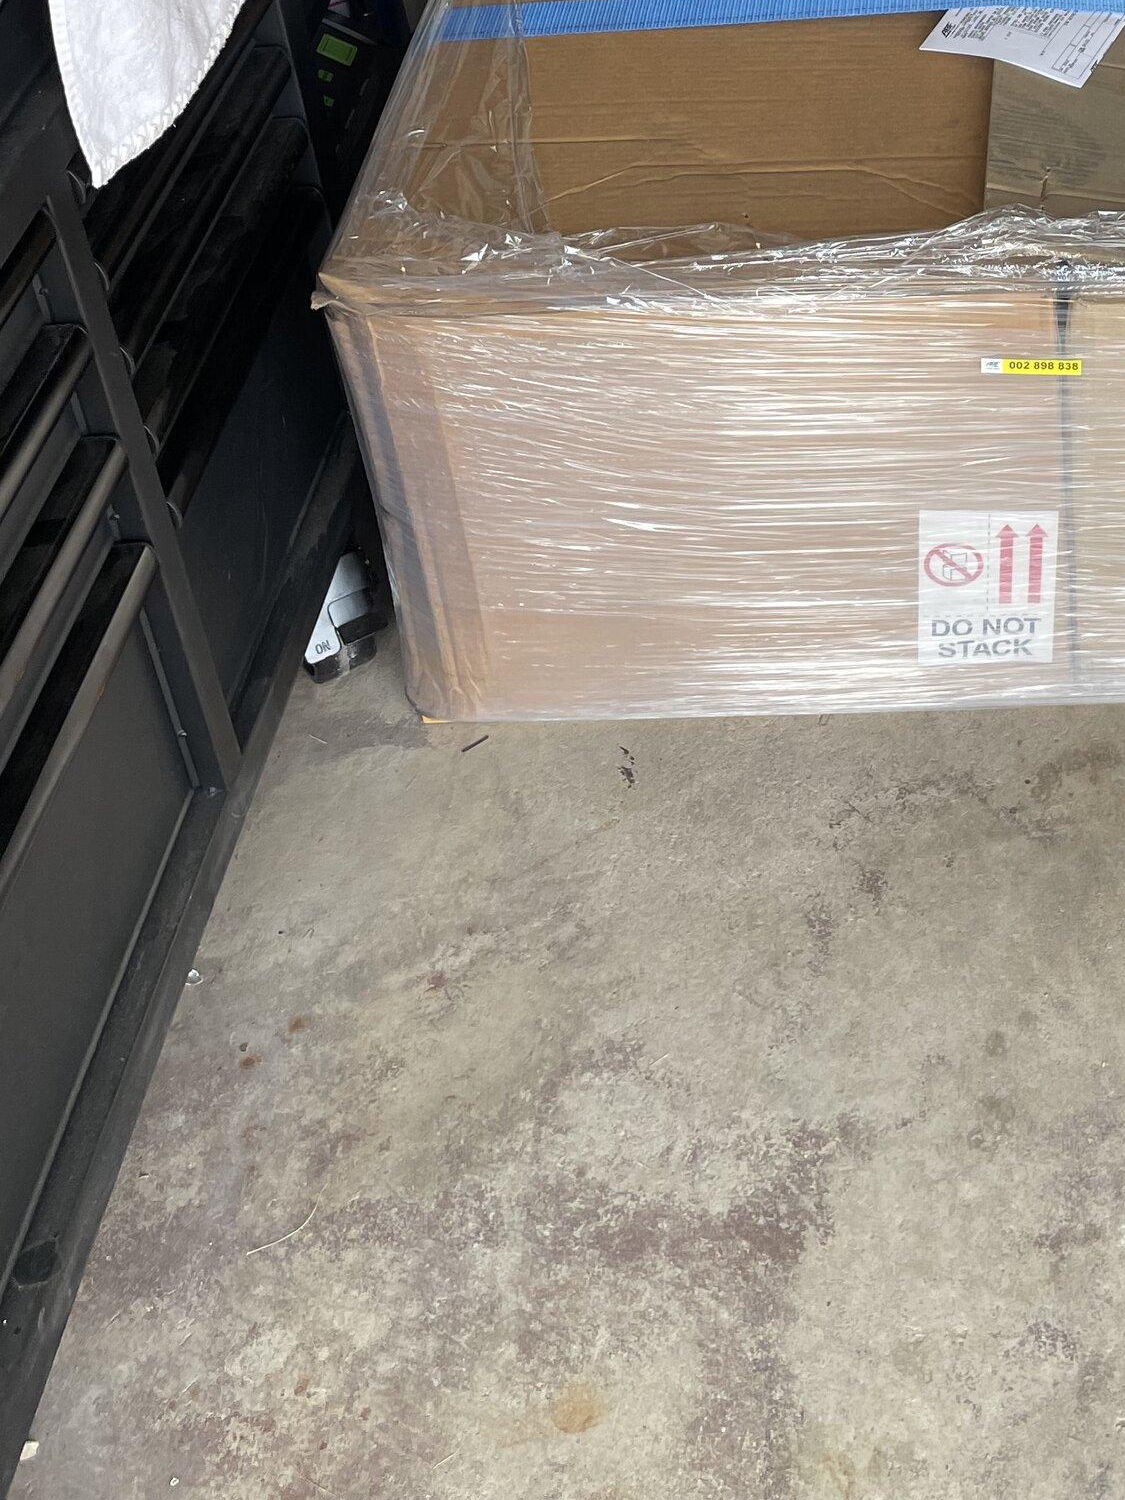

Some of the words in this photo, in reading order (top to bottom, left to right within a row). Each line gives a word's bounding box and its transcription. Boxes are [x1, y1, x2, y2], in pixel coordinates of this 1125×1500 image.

[1009, 361, 1030, 370] 002
[1033, 361, 1054, 370] 898
[1058, 362, 1079, 370] 838
[931, 618, 974, 638] DO
[982, 617, 1042, 636] NOT
[315, 639, 332, 655] ON
[938, 637, 1033, 659] STACK
